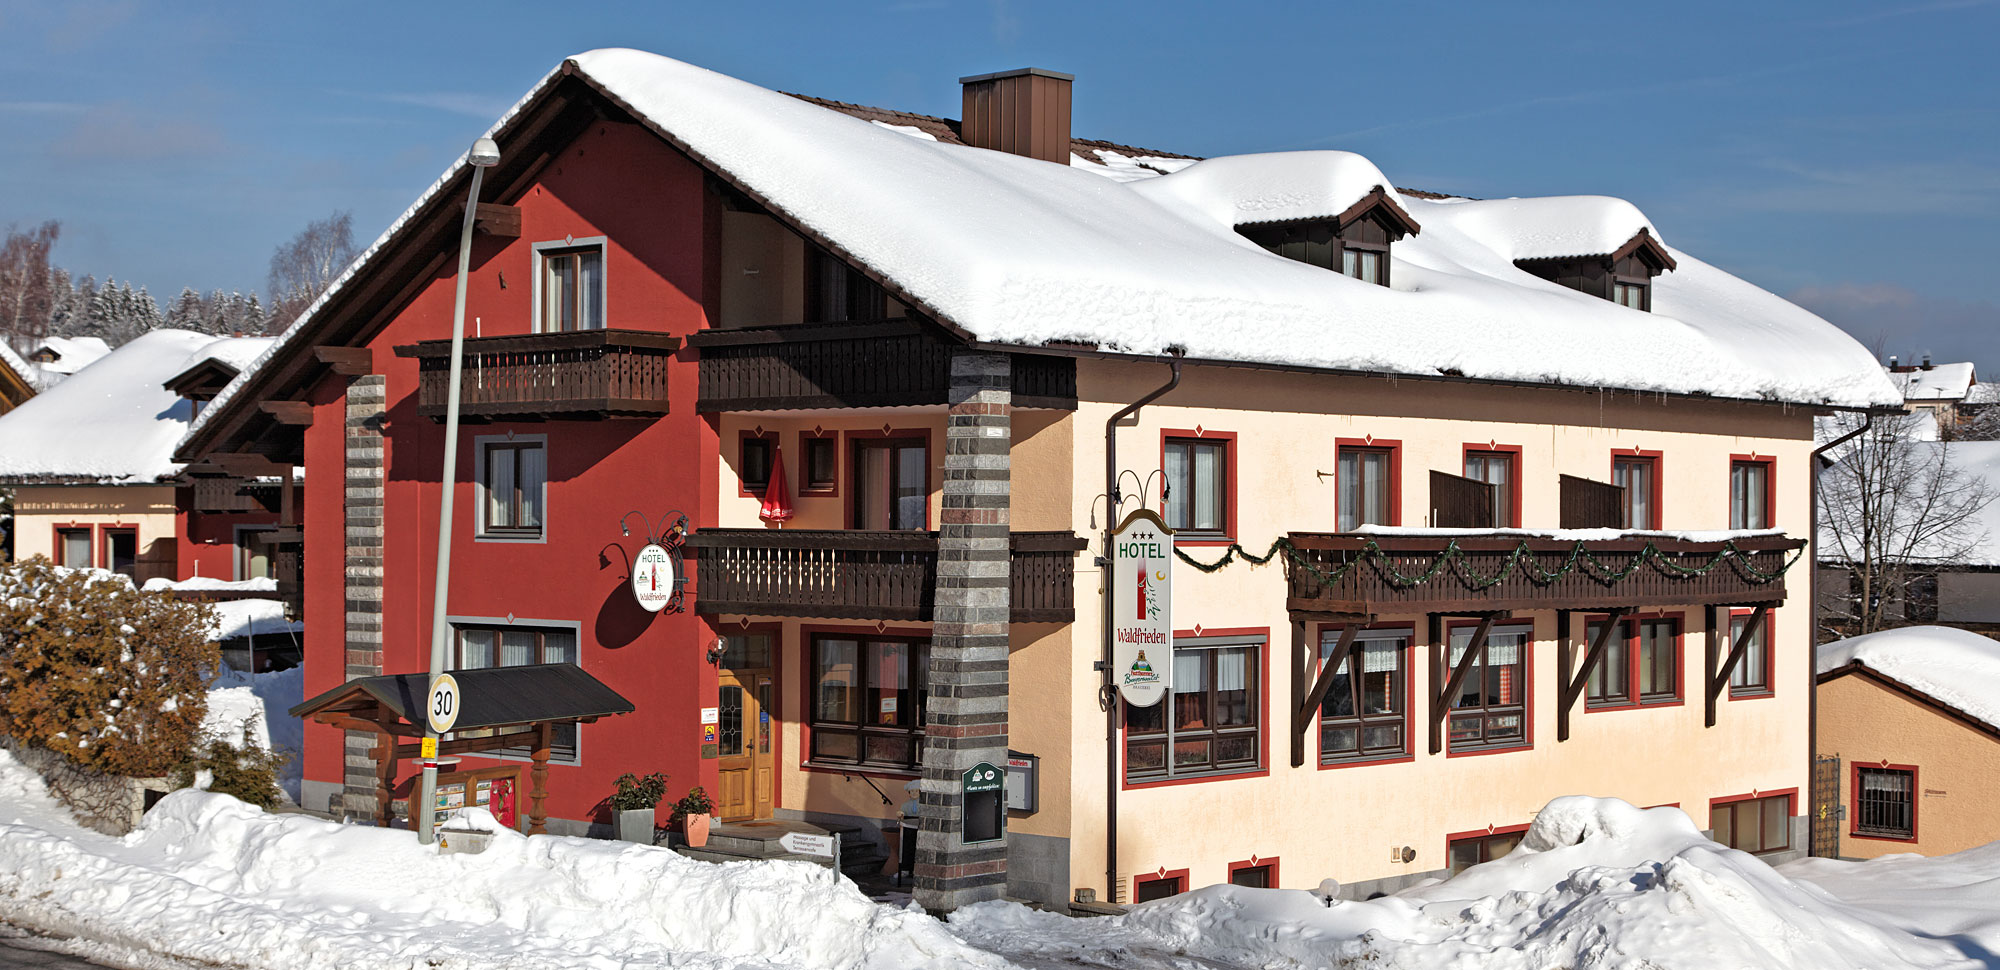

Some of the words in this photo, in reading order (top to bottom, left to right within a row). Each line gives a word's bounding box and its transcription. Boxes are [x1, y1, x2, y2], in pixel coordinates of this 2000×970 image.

[1119, 543, 1165, 558] HOTEL
[642, 554, 666, 563] HOTEL
[640, 593, 667, 602] Waldfrieden
[1117, 627, 1166, 645] Waldfrieden
[434, 690, 453, 716] 30
